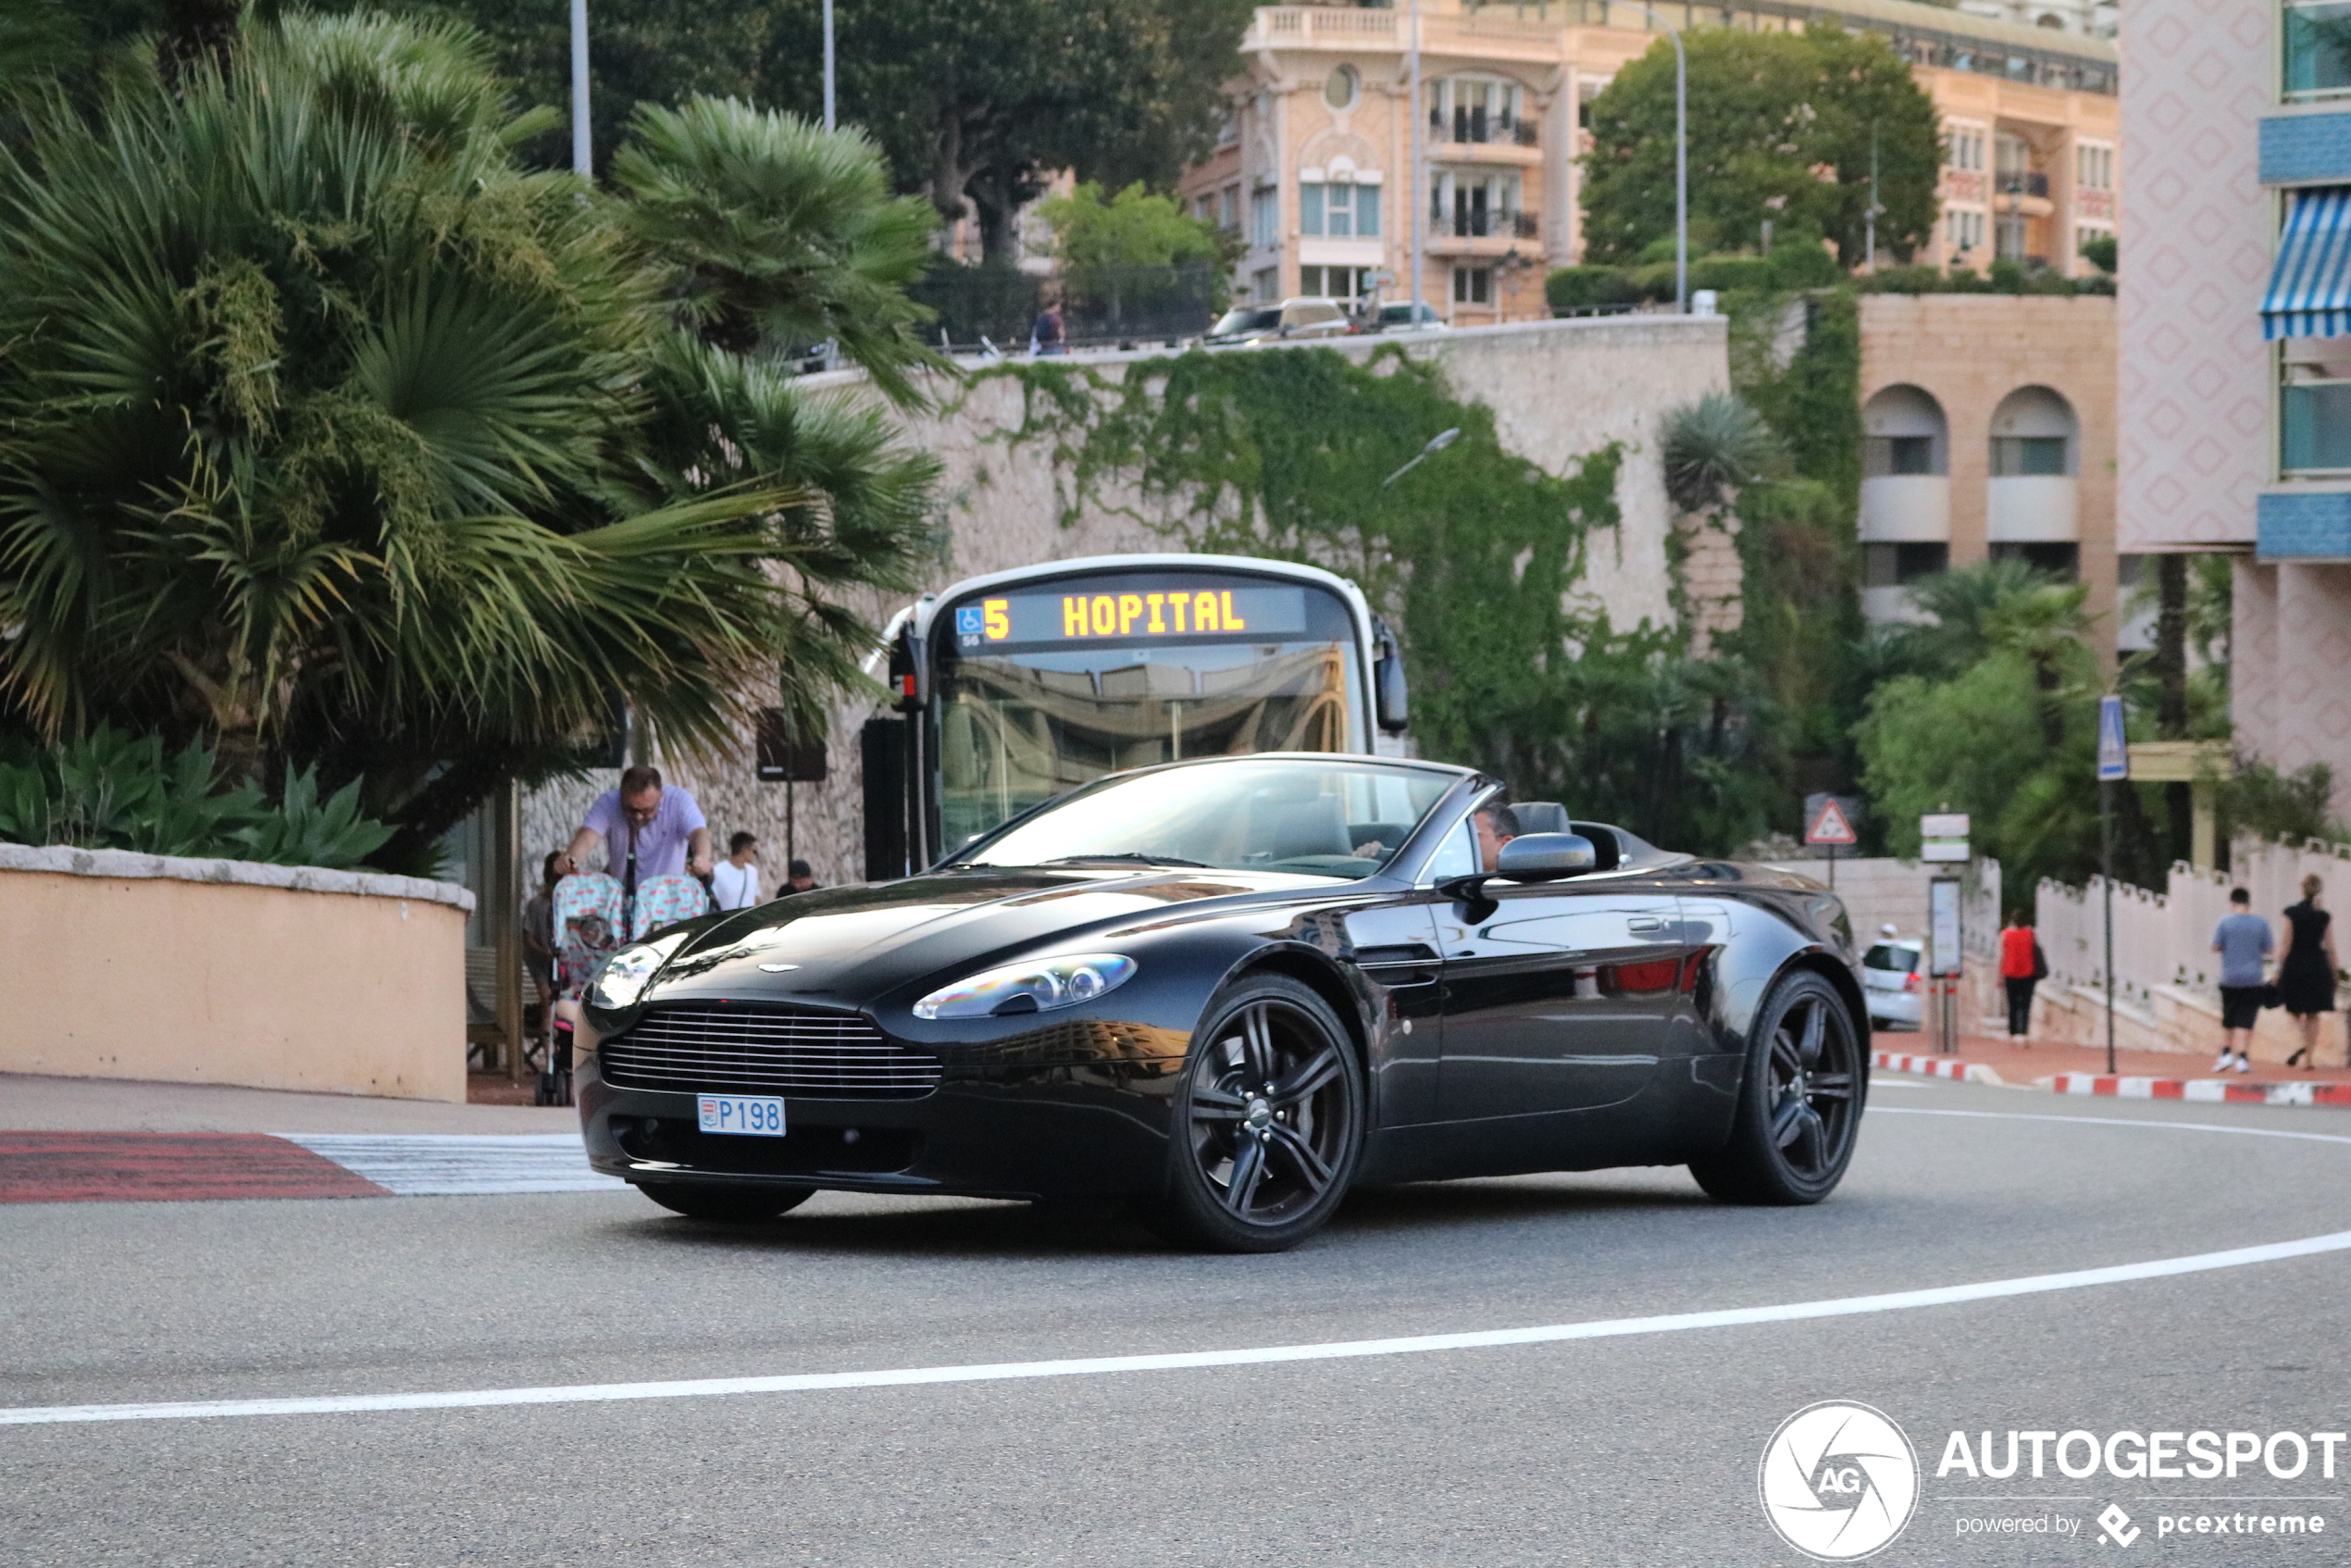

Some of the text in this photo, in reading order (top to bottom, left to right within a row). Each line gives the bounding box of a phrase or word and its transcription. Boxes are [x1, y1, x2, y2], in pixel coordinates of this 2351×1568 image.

[984, 591, 1245, 640] 5 HOPITAL
[720, 1101, 779, 1130] P198
